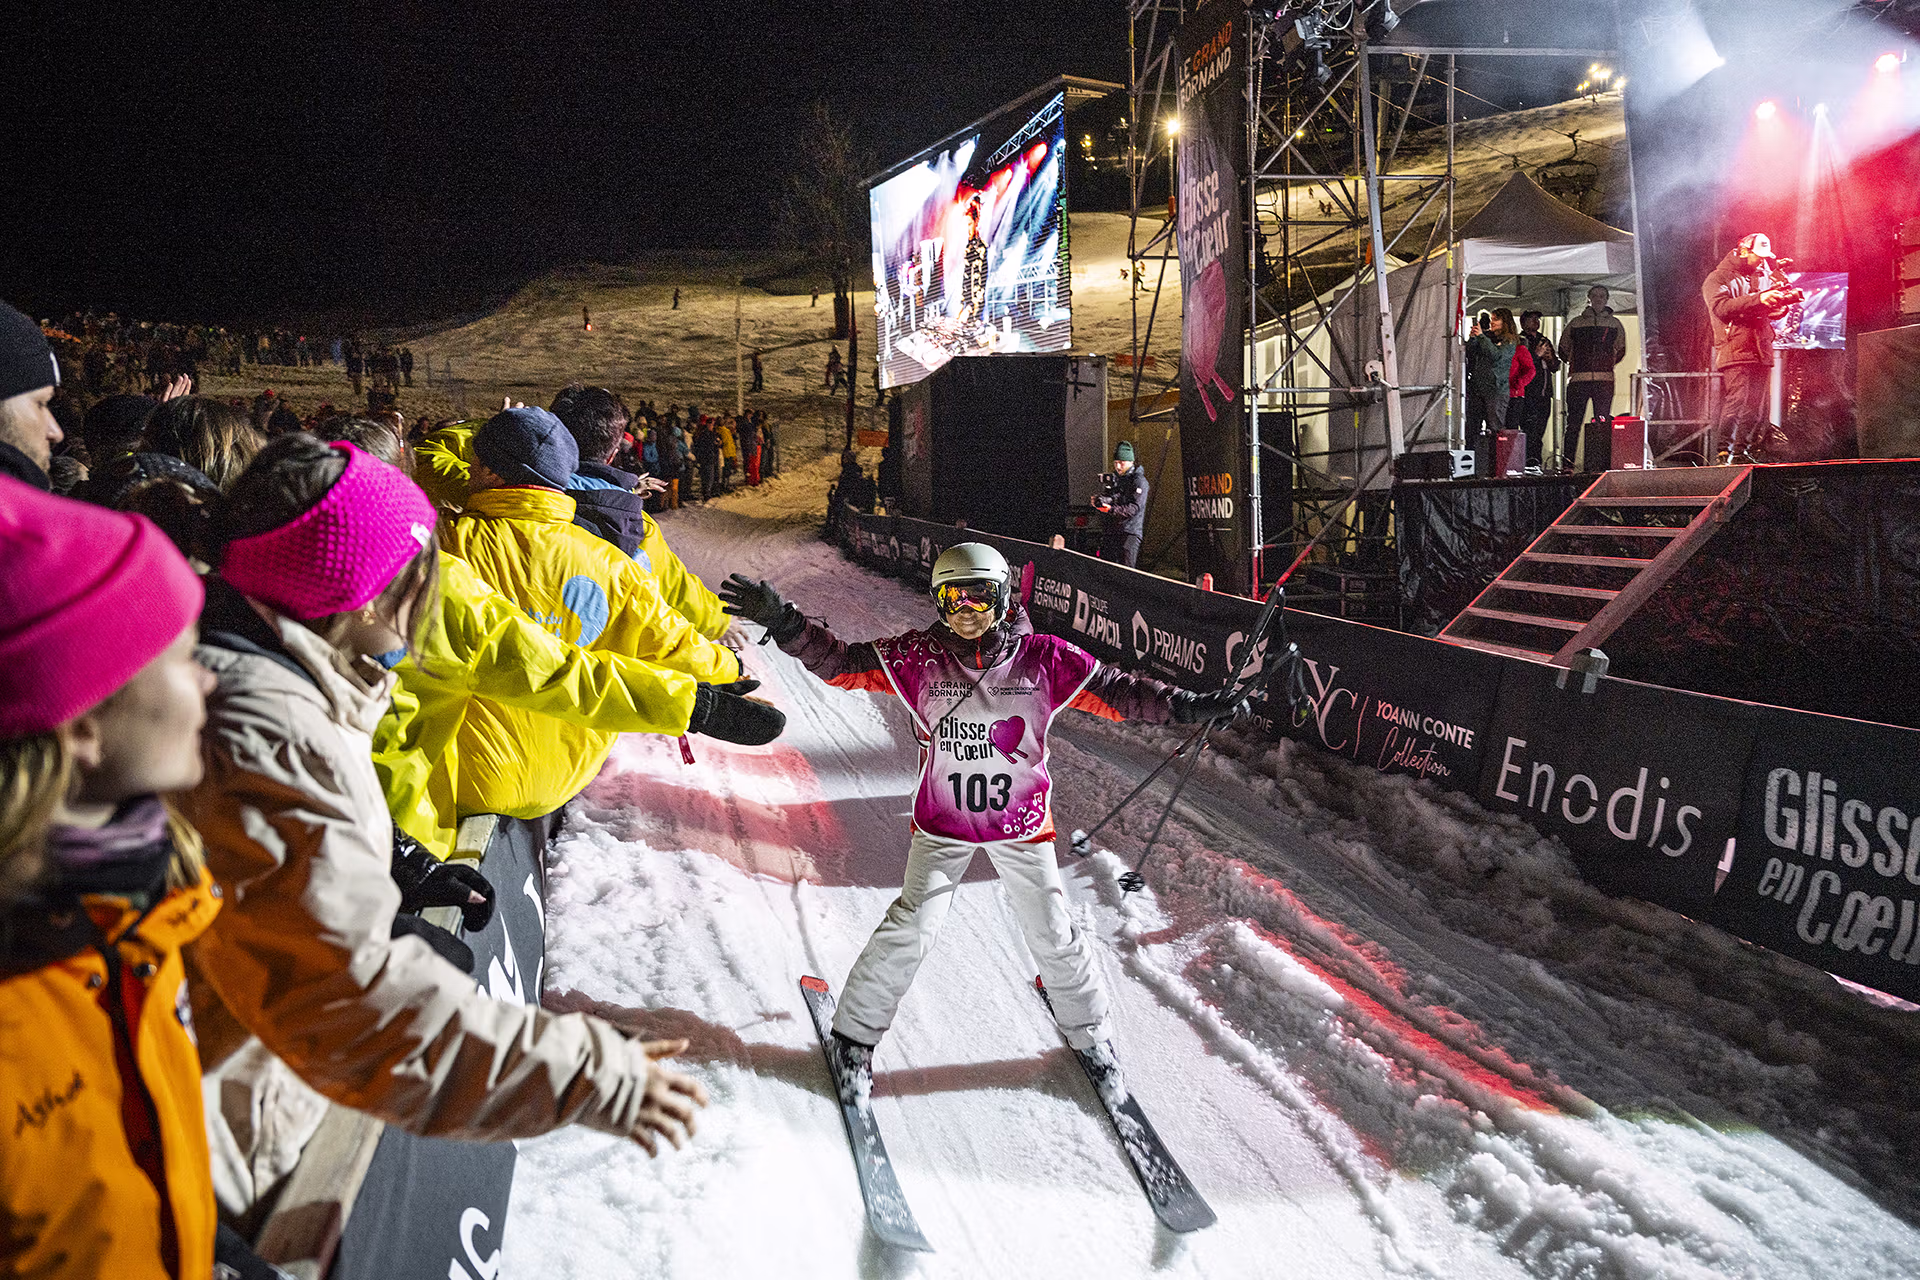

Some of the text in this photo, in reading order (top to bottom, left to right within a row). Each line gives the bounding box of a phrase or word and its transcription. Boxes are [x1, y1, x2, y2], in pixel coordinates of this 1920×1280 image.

[1179, 20, 1232, 86] LE GRAND
[1180, 46, 1231, 110] BORNAND
[1187, 472, 1233, 496] LE GRAND
[1190, 497, 1233, 519] BORNAND
[1033, 590, 1070, 614] BORNAND
[1035, 575, 1045, 591] LE
[1044, 578, 1072, 599] GRAND
[1086, 613, 1123, 650] APICIL
[1153, 627, 1207, 674] PRIAMS
[929, 681, 973, 690] LE GRAND
[929, 689, 973, 698] BORNAND
[939, 716, 986, 741] Glisse
[1376, 700, 1475, 750] YOANN CONTE
[940, 740, 994, 762] en Cœur
[1378, 726, 1452, 779] Collection
[947, 771, 1013, 813] 103
[1495, 736, 1702, 857] Enodis
[1757, 857, 1805, 905] en
